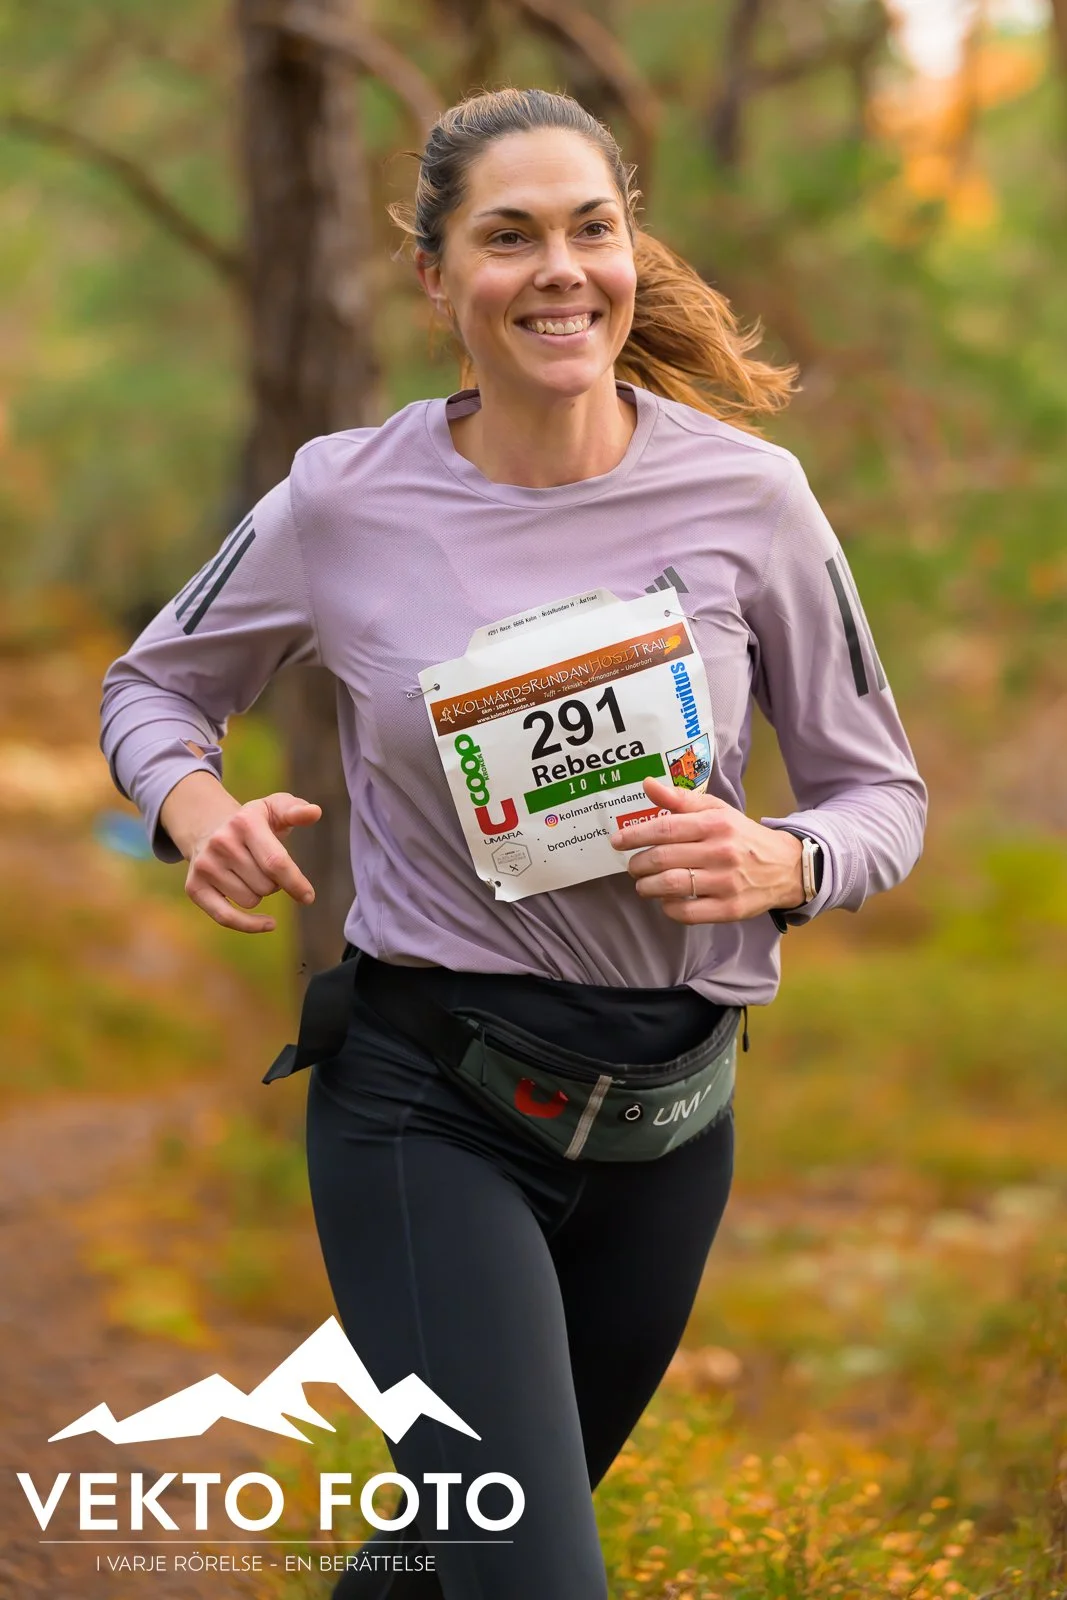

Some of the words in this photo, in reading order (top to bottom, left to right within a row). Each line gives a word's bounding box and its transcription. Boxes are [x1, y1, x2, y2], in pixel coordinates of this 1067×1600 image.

[523, 686, 627, 760] 291
[670, 661, 701, 739] Aktivitus
[454, 733, 490, 807] coop
[532, 740, 646, 787] Rebecca
[569, 779, 588, 795] 10
[600, 768, 622, 785] KM
[483, 830, 524, 846] UMARA
